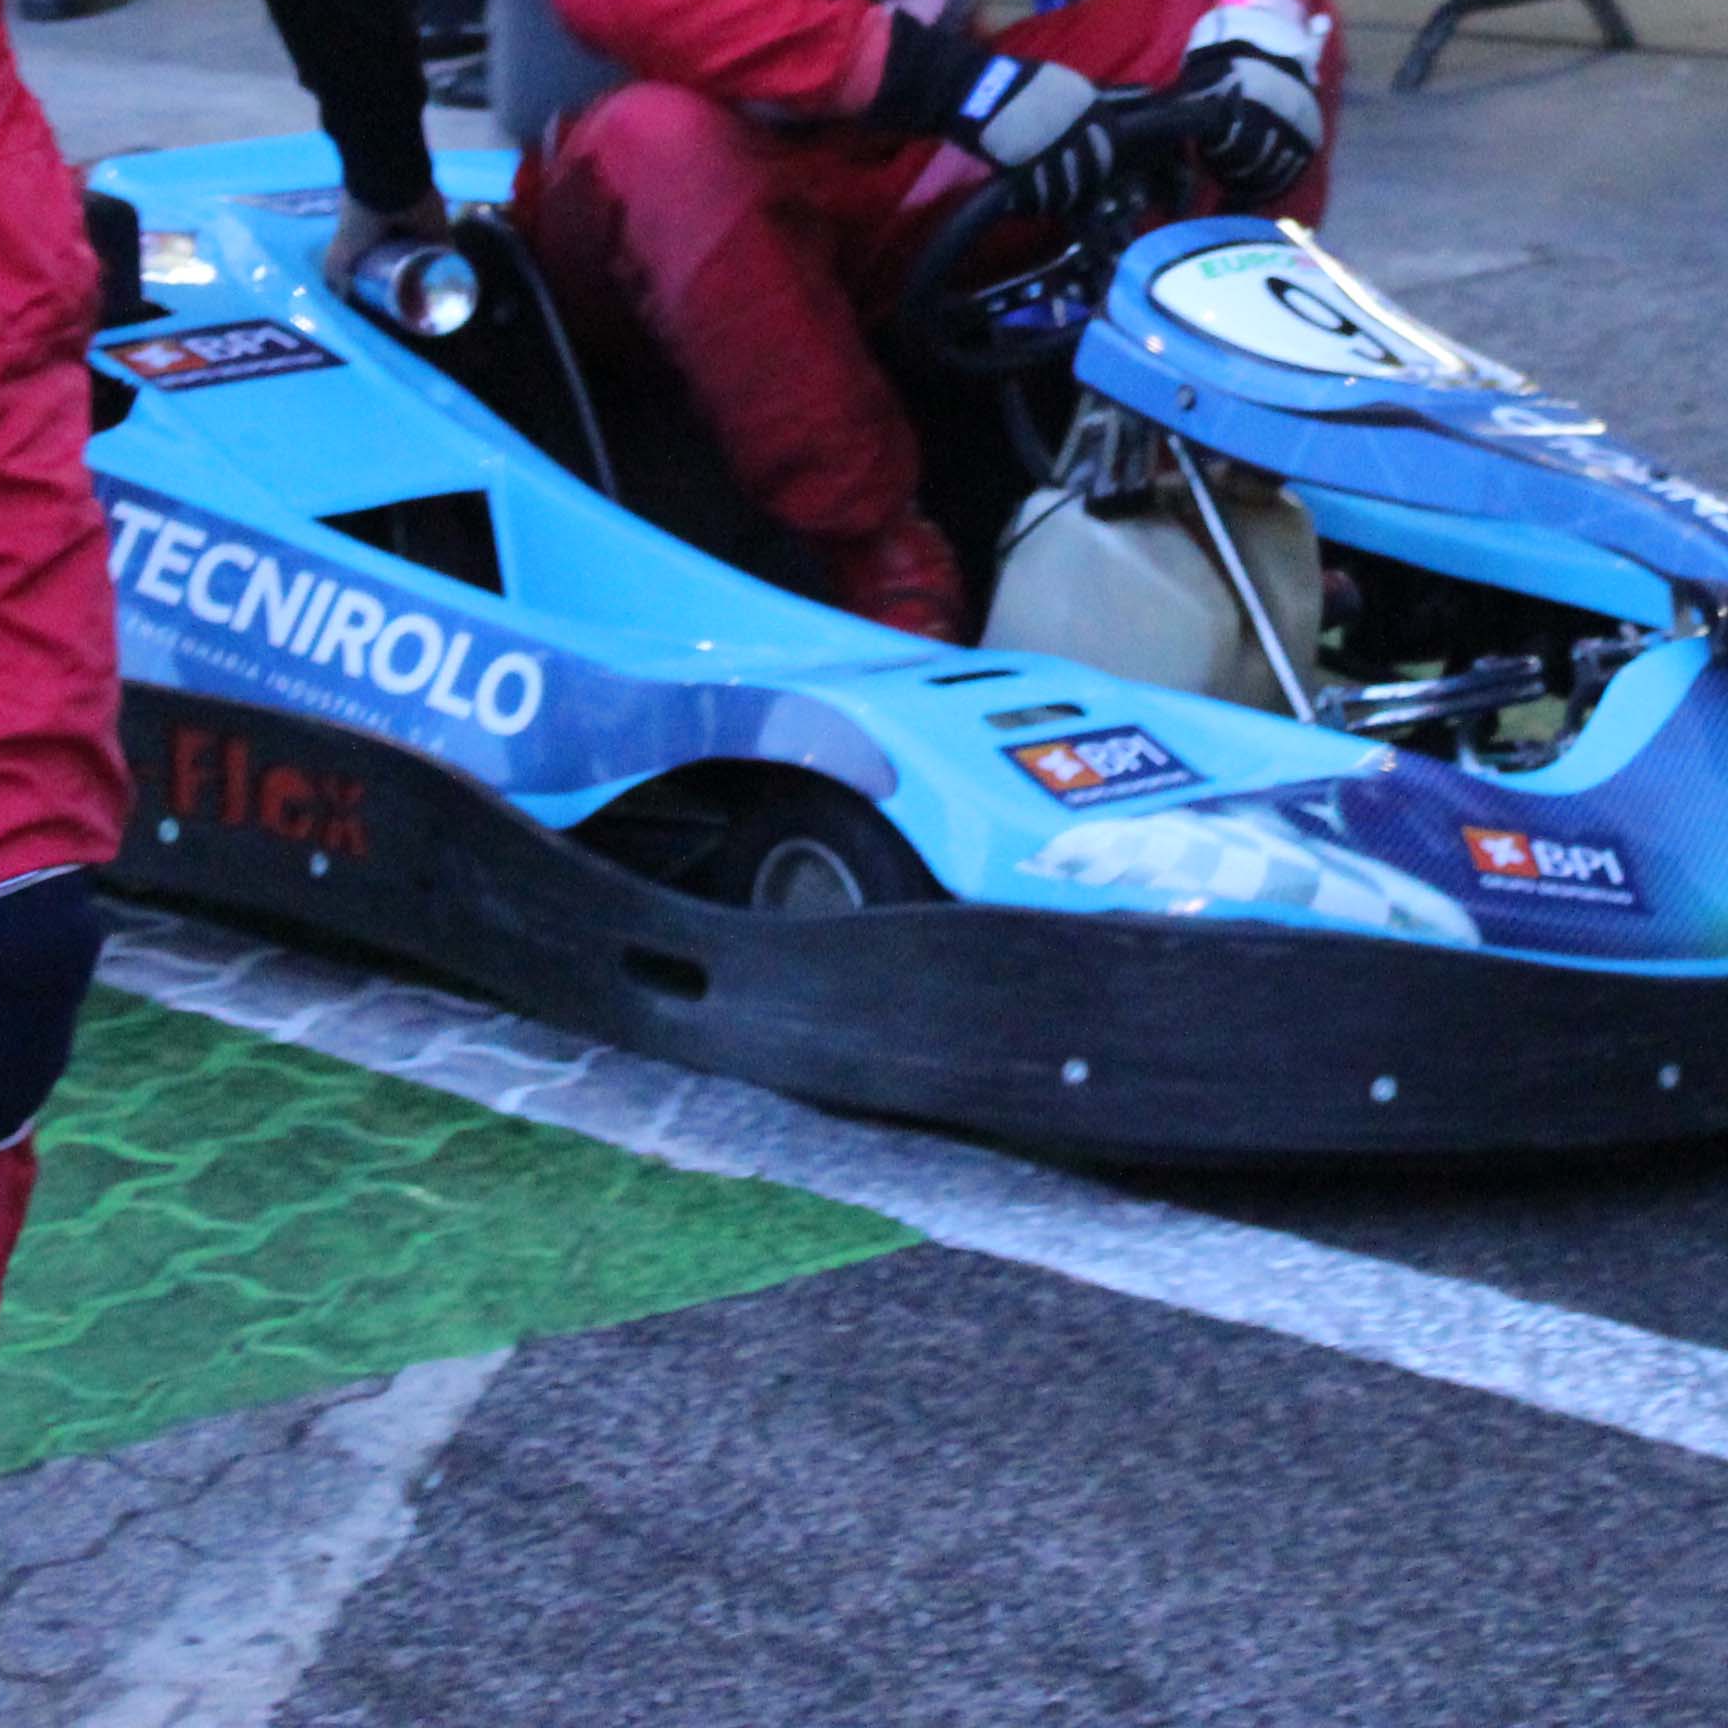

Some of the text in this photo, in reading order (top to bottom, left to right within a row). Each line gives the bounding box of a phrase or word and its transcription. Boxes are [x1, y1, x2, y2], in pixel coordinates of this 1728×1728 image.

[181, 326, 300, 363] BPI
[1267, 276, 1406, 368] 9
[108, 500, 544, 737] TECNIROLO
[1074, 733, 1170, 778] BPI
[1531, 838, 1624, 886] BPI
